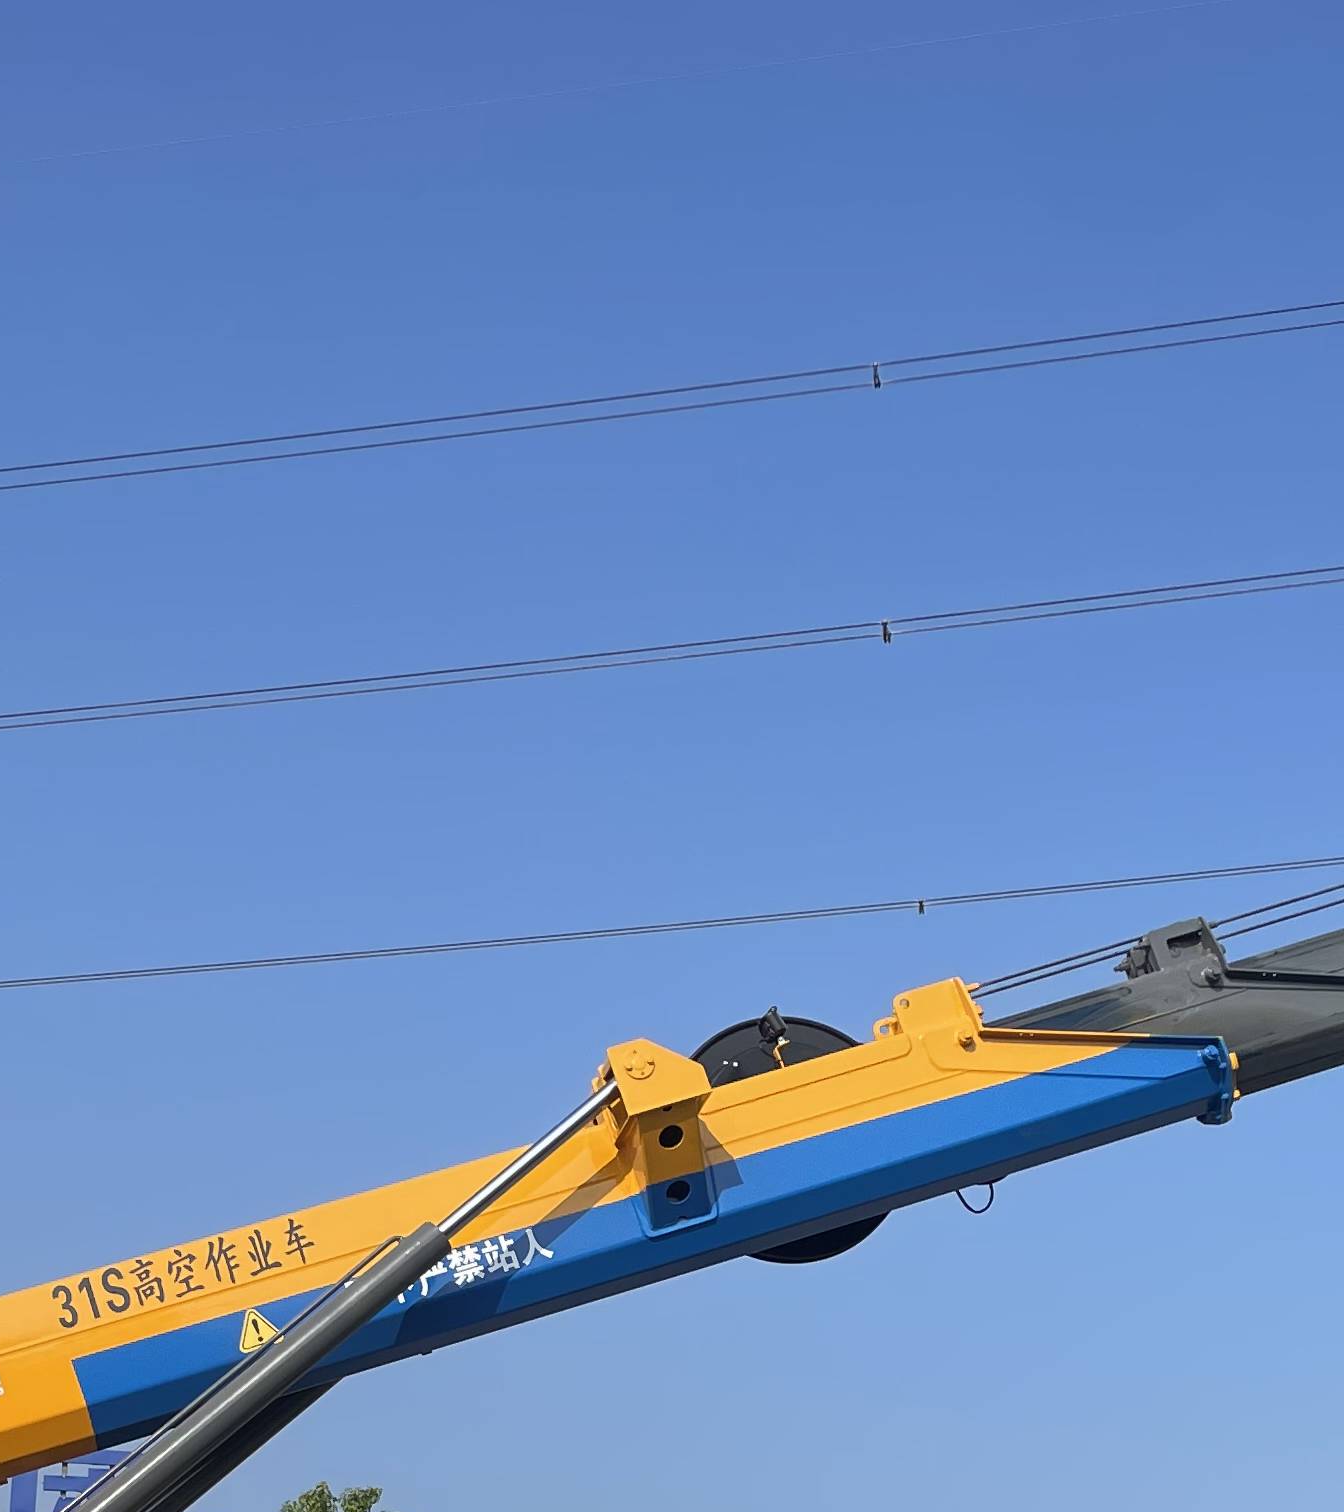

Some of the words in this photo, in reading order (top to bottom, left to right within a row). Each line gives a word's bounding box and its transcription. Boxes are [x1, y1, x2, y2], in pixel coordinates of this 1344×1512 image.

[52, 1219, 315, 1328] 31S高空作业车
